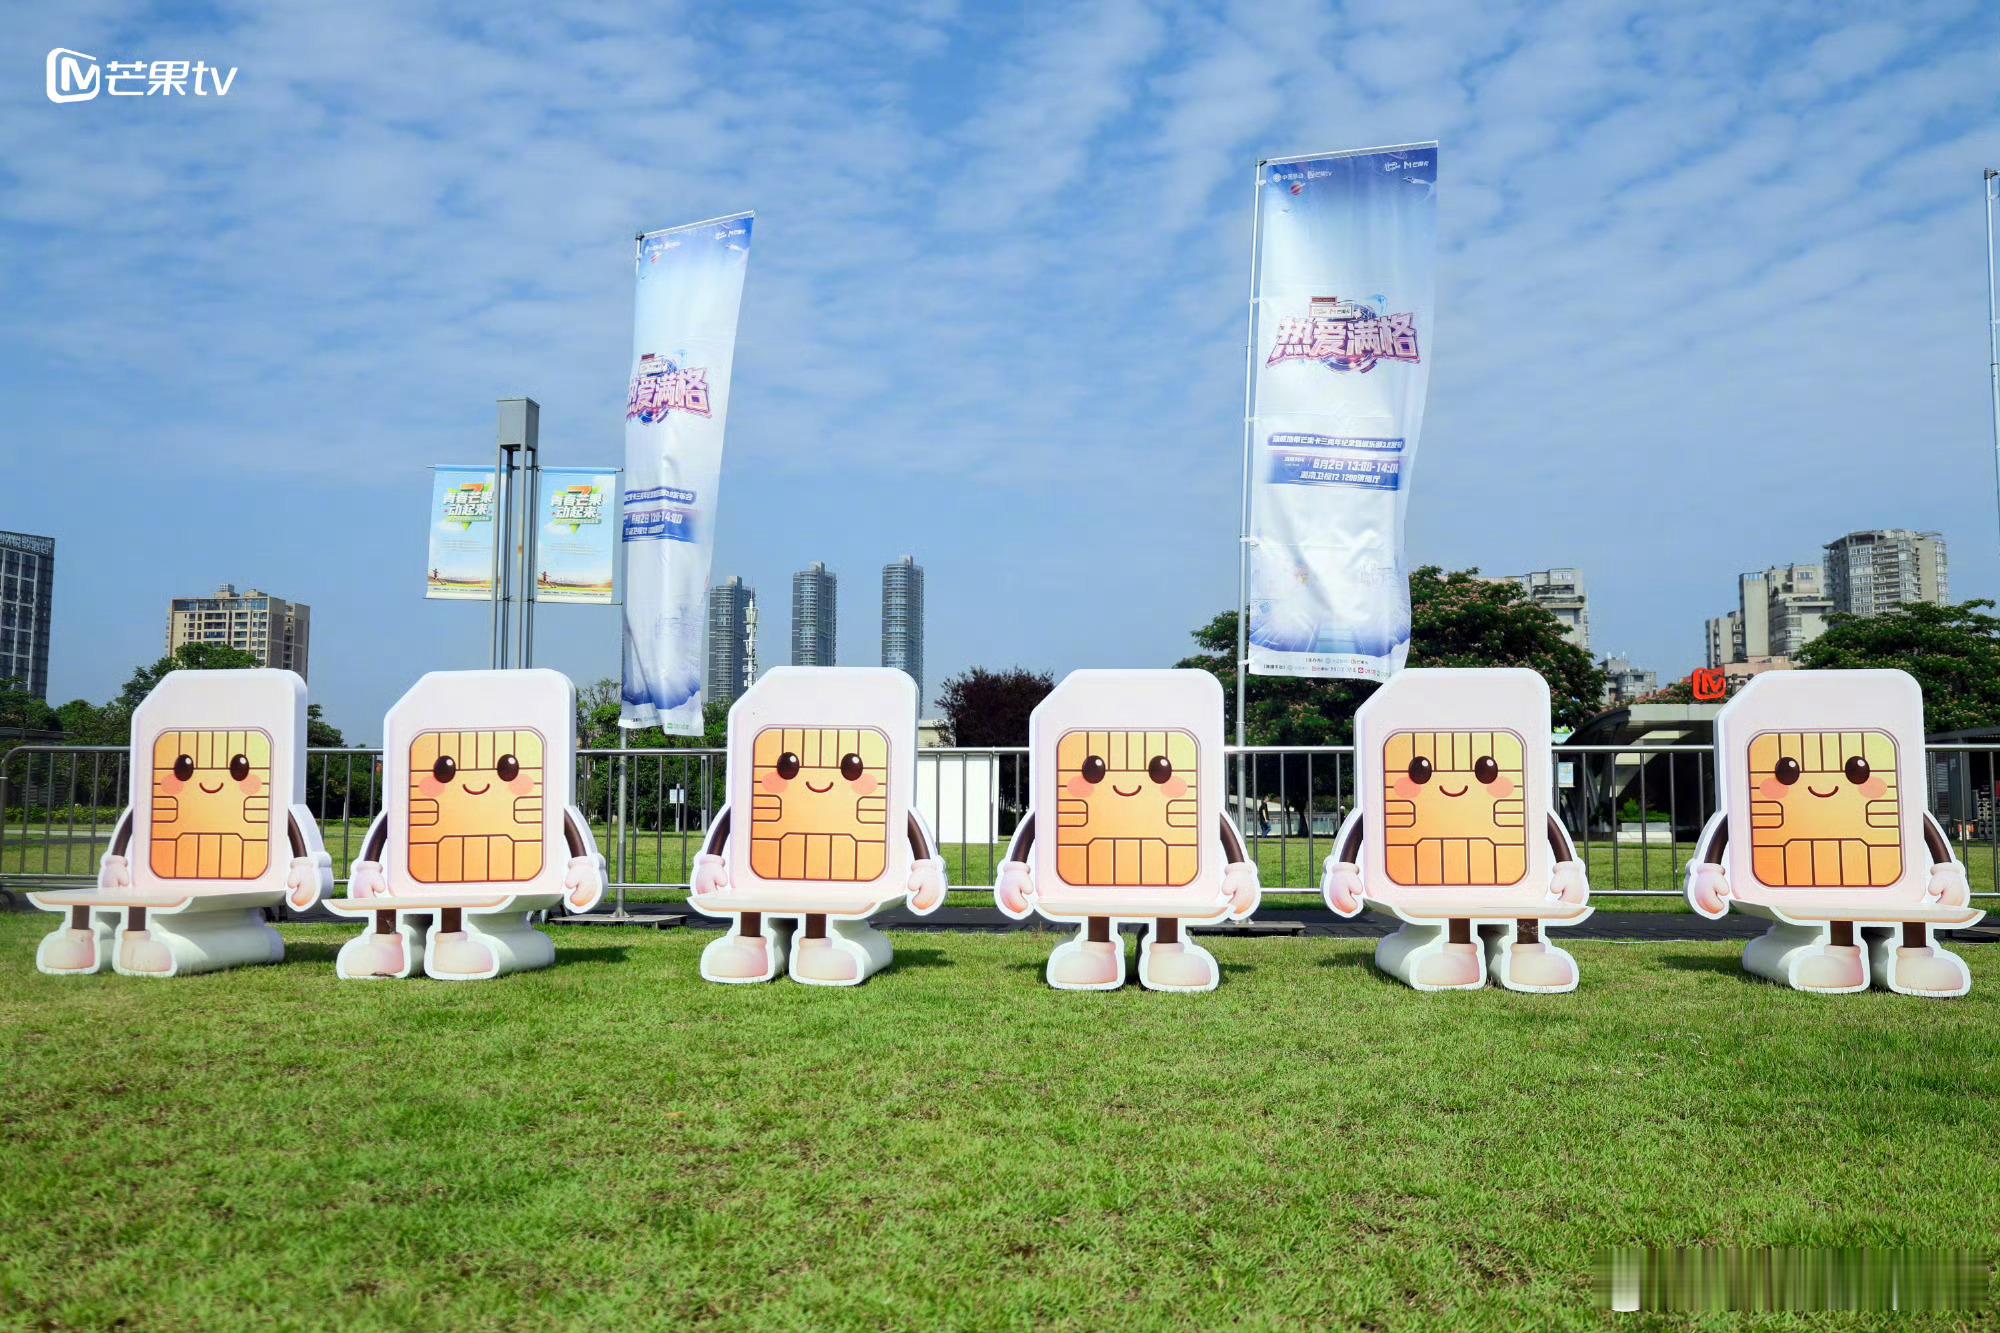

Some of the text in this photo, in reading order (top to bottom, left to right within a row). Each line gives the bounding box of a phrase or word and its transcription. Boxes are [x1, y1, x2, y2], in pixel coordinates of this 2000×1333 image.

[1266, 313, 1420, 367] 热爱满格
[1313, 458, 1344, 470] 6月2日
[448, 503, 488, 516] 动起来
[555, 506, 598, 519] 动起来
